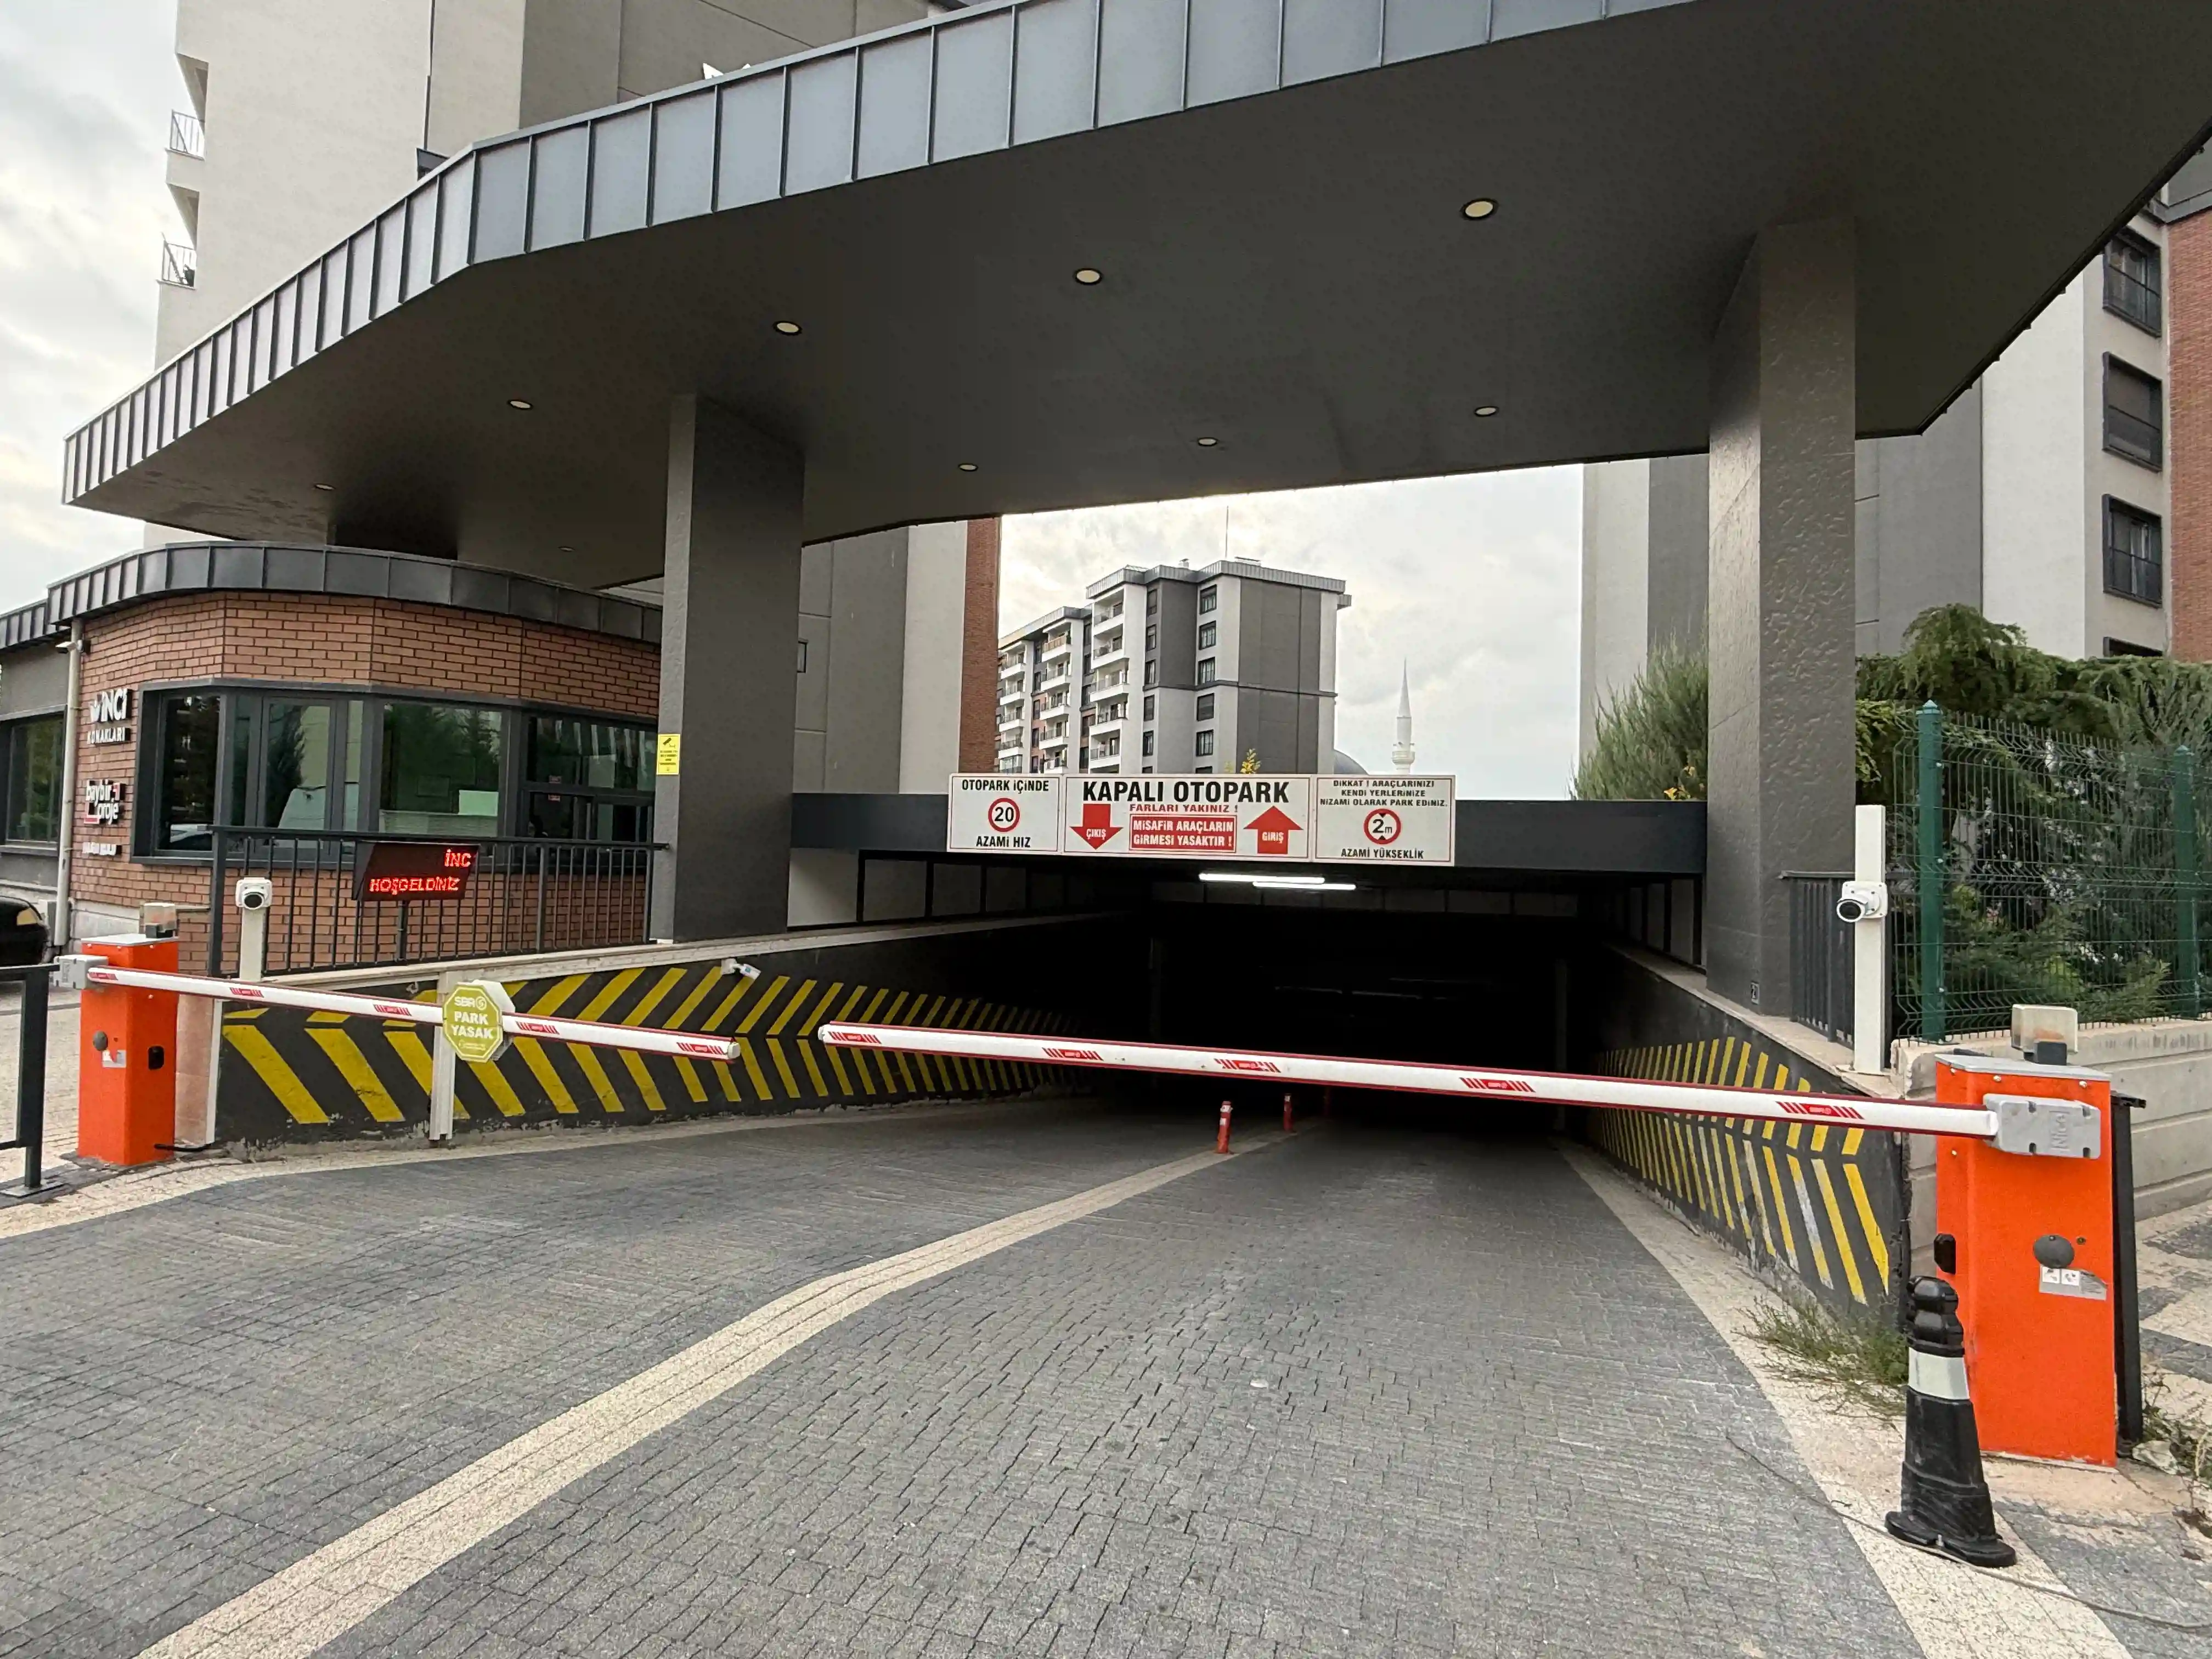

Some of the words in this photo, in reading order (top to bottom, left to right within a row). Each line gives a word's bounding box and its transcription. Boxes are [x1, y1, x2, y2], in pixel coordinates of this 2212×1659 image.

[962, 780, 1009, 791] OTOPARK
[1013, 780, 1049, 794] İÇİNDE
[1083, 781, 1163, 802] KAPALI
[1173, 781, 1289, 803] OTOPARK
[994, 807, 1014, 822] 20
[1130, 804, 1178, 812] FARLARI
[1183, 804, 1229, 812] YAKINIZ
[1133, 820, 1173, 831] MİSAFİR
[1176, 821, 1233, 834] ARAÇLARIN
[1086, 828, 1106, 840] ÇIKIŞ
[1133, 834, 1175, 845] GİRMESİ
[1177, 836, 1224, 847] YASAKTIR
[1228, 836, 1232, 847] !
[1262, 832, 1284, 844] GİRİŞ
[976, 836, 1009, 847] AZAMİ
[1013, 837, 1031, 848] HIZ
[1341, 847, 1370, 857] AZAMİ
[1373, 847, 1424, 859] YÜKSEKLİK
[454, 1011, 489, 1025] PARK
[451, 1025, 494, 1039] YASAK
